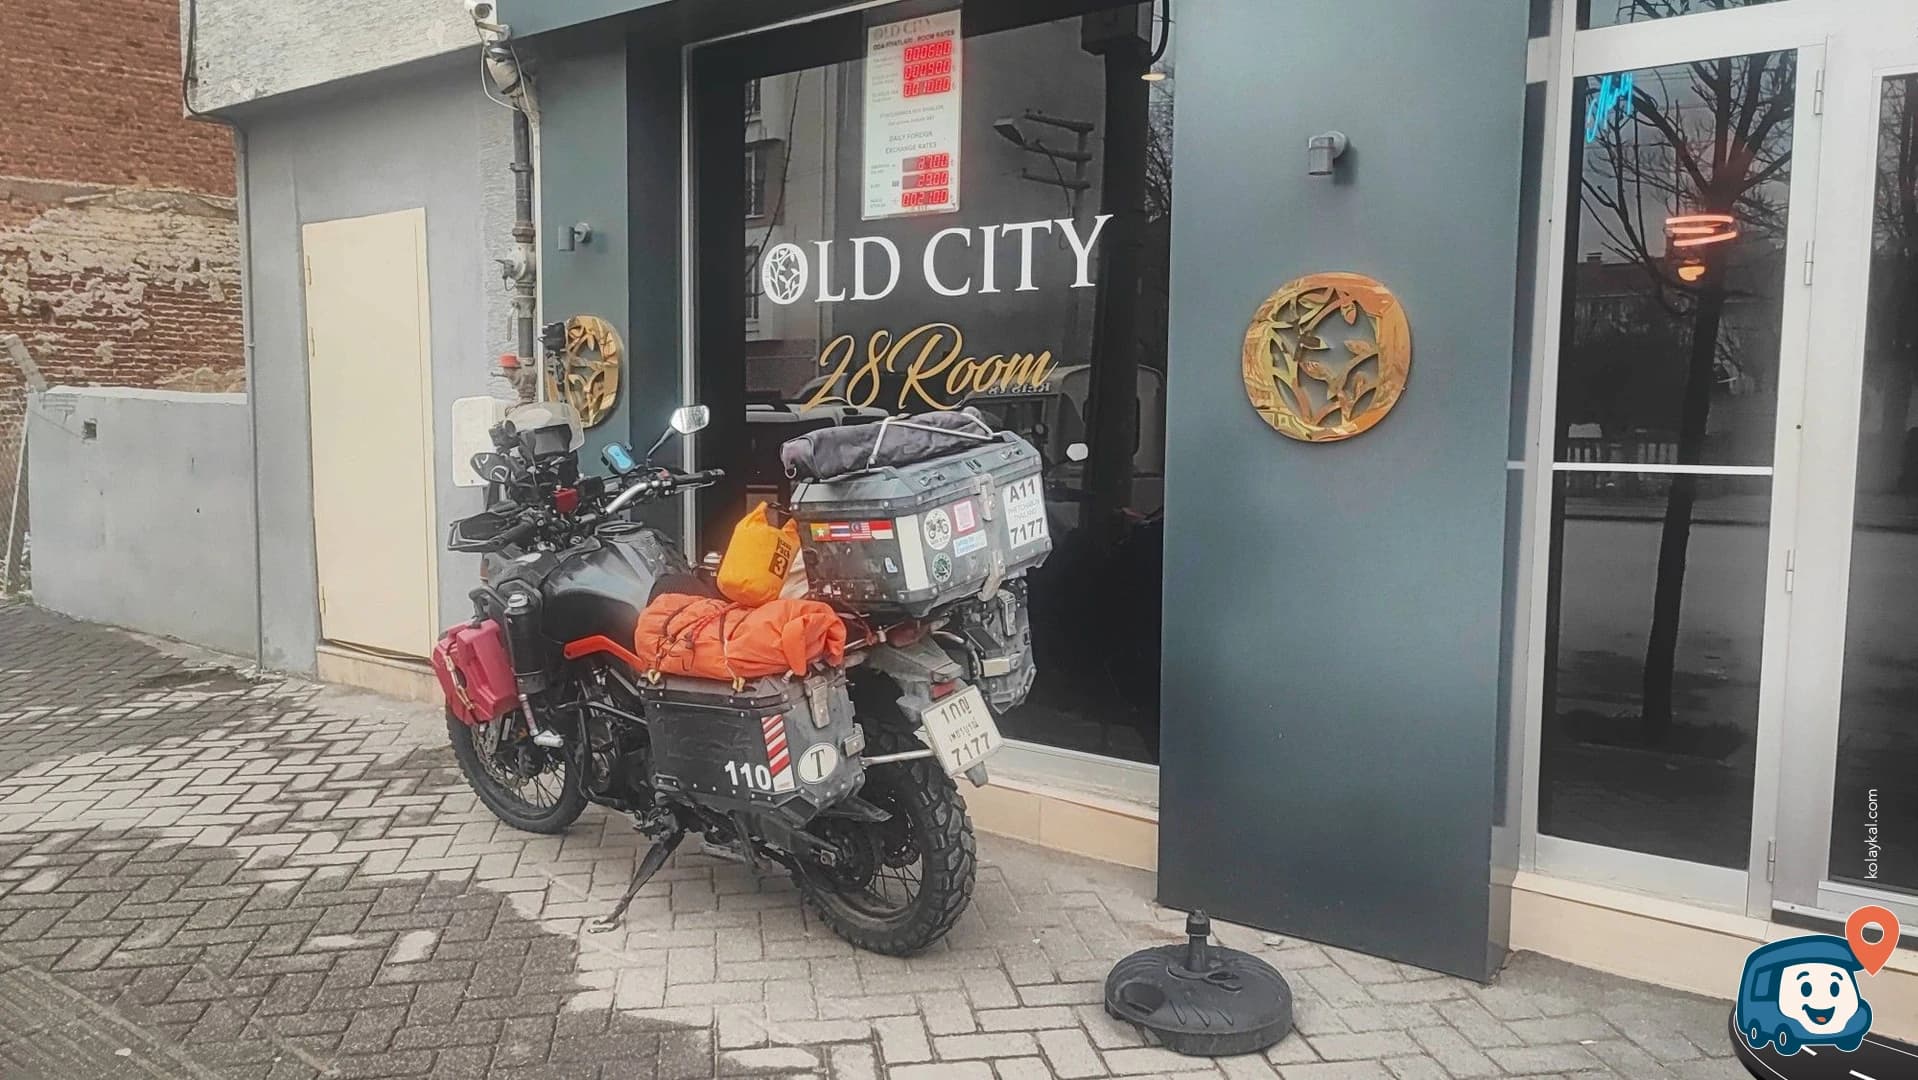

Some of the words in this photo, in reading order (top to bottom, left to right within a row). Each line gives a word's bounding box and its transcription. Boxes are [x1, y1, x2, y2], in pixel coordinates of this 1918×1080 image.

[885, 145, 916, 154] EXCHANGE
[918, 142, 936, 150] RATES
[762, 236, 901, 305] OLD
[923, 214, 1115, 297] CITY
[1009, 478, 1036, 503] A11
[1010, 517, 1044, 545] 7177
[809, 747, 827, 780] T
[951, 732, 991, 767] 7177
[724, 760, 771, 791] 110
